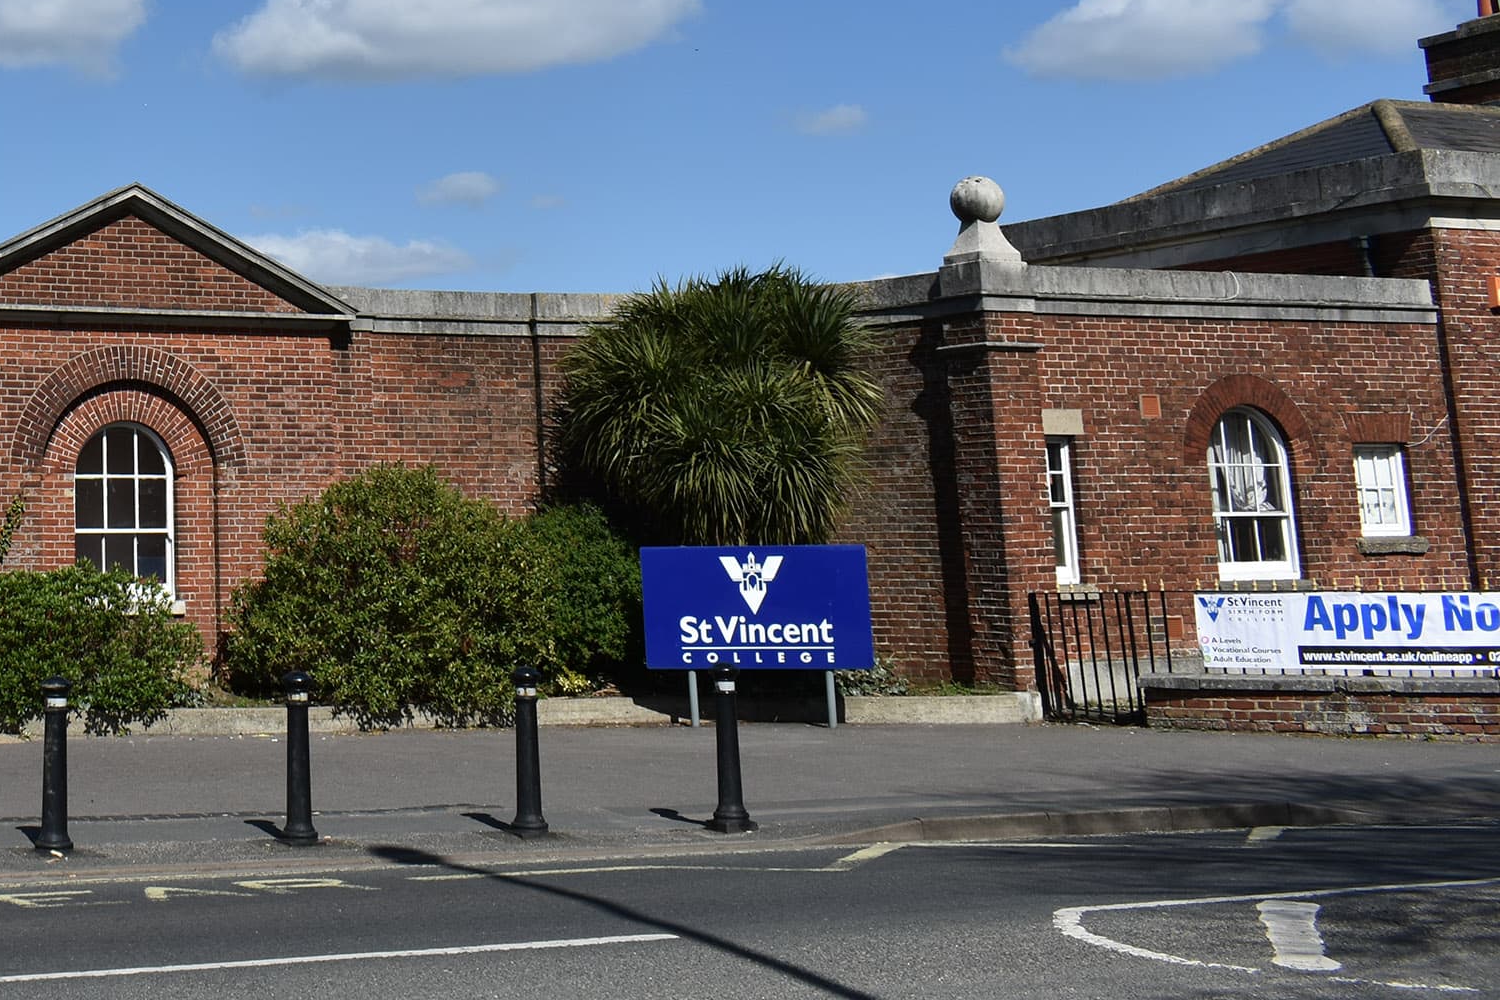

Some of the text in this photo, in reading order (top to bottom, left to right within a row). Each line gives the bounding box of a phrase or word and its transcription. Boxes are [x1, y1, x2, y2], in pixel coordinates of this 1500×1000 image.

[1227, 596, 1283, 607] St Vincent
[1303, 595, 1426, 640] Apply
[679, 615, 834, 643] St Vincent
[682, 652, 836, 664] COLLEGE
[1302, 651, 1473, 664] www.stvincent.ac.uk/onlineapp
